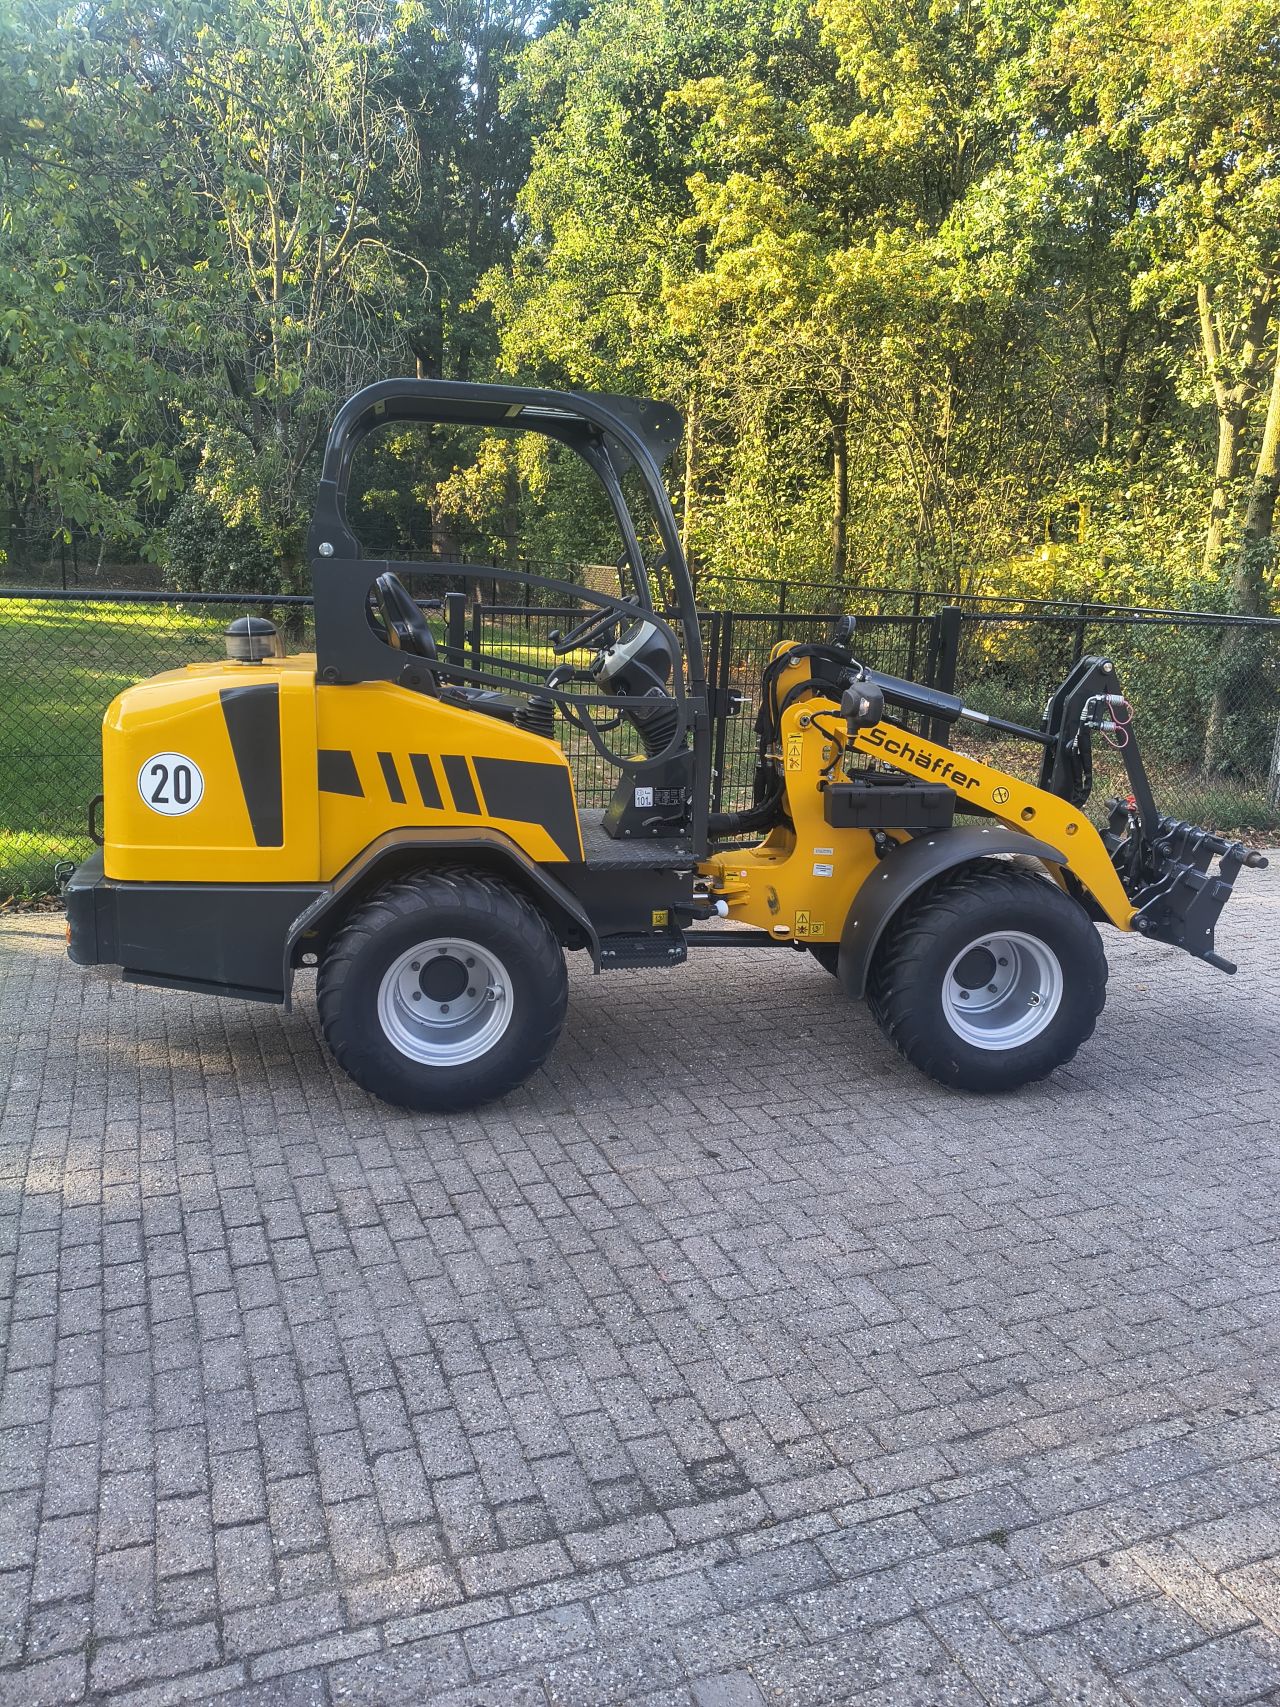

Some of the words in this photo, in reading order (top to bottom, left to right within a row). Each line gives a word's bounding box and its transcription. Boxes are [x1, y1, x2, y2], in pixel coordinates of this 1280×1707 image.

[860, 728, 980, 789] Schäffer
[151, 764, 191, 804] 20
[637, 796, 649, 806] 101
